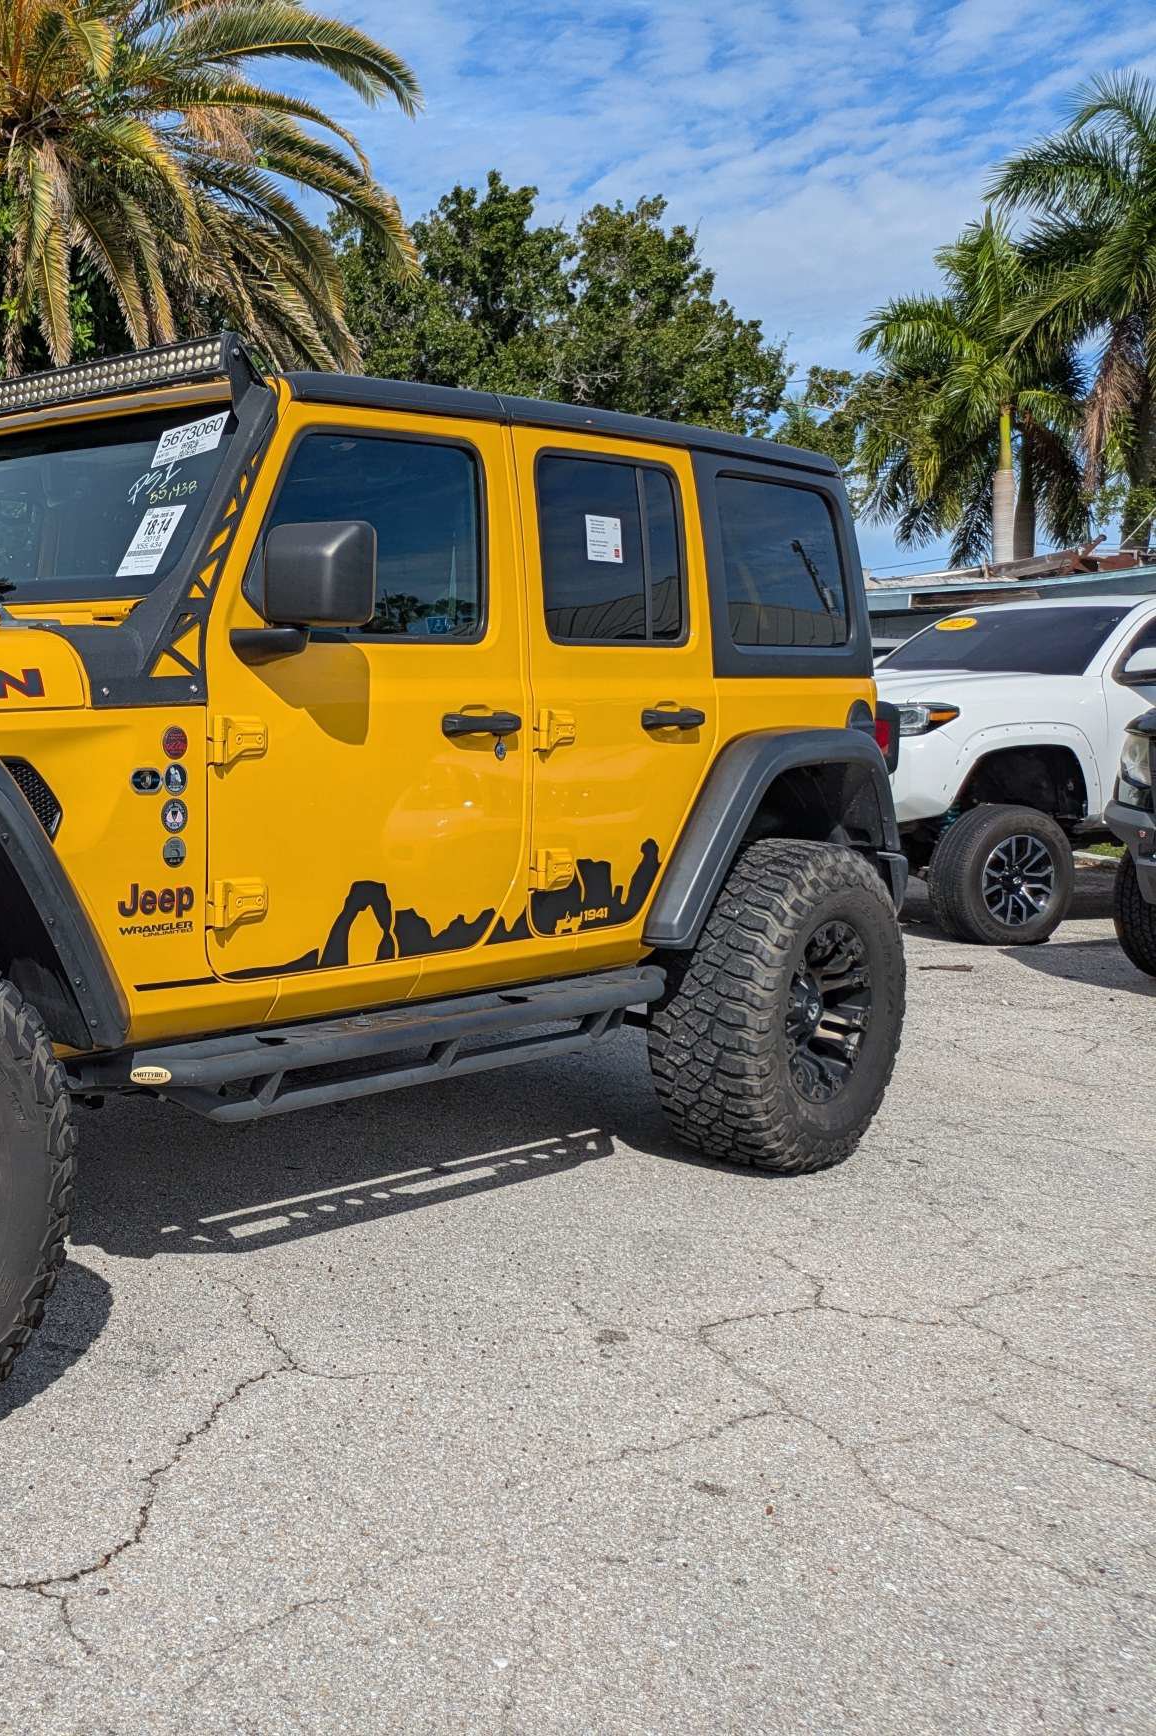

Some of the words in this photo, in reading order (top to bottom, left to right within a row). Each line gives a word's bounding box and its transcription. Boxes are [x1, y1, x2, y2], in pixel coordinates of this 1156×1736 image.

[162, 417, 224, 448] 5673060
[149, 480, 197, 504] 55,438
[144, 517, 173, 536] 18:14
[118, 883, 194, 918] Jeep
[584, 907, 608, 921] 1941
[119, 921, 193, 936] WRANGLER
[143, 928, 194, 938] UNLIMITED
